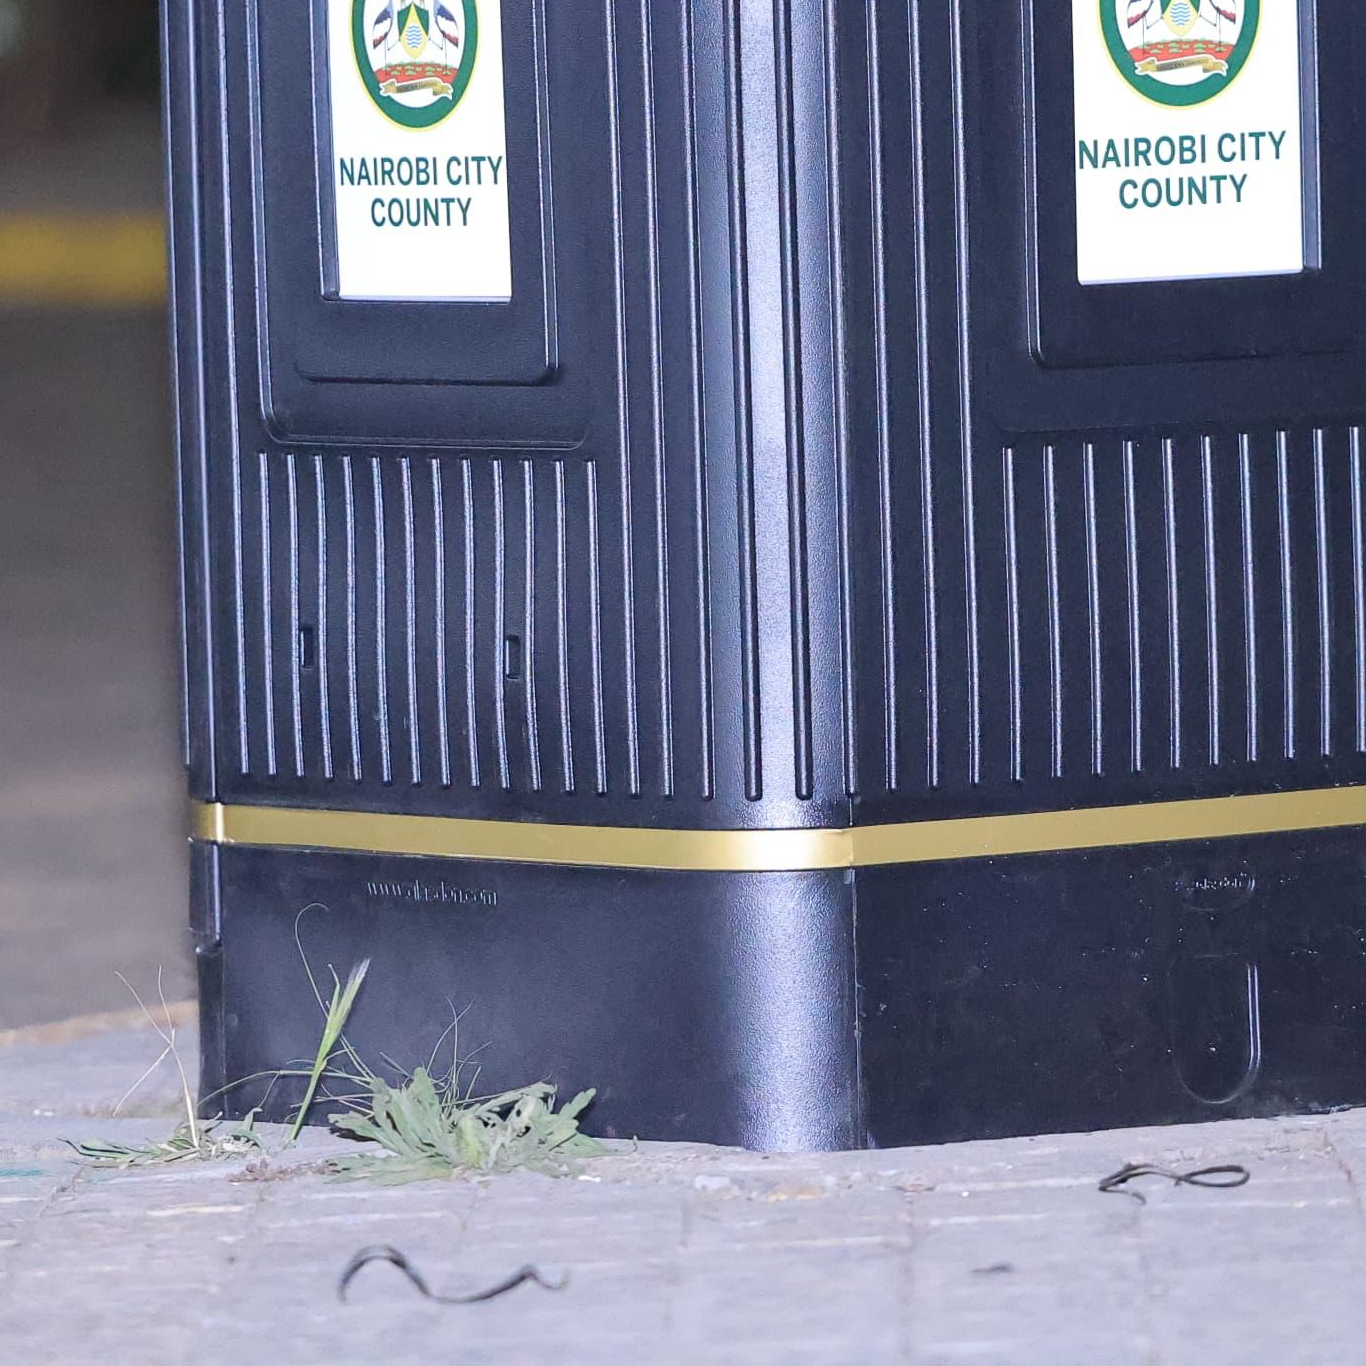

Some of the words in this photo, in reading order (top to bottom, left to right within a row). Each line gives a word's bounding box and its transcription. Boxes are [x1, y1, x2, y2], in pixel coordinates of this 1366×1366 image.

[1077, 134, 1207, 170] NAIROBI
[1217, 130, 1288, 163] CITY
[338, 156, 439, 187] NAIROBI
[446, 155, 504, 186] CITY
[1117, 173, 1249, 210] COUNTY
[369, 197, 473, 228] COUNTY
